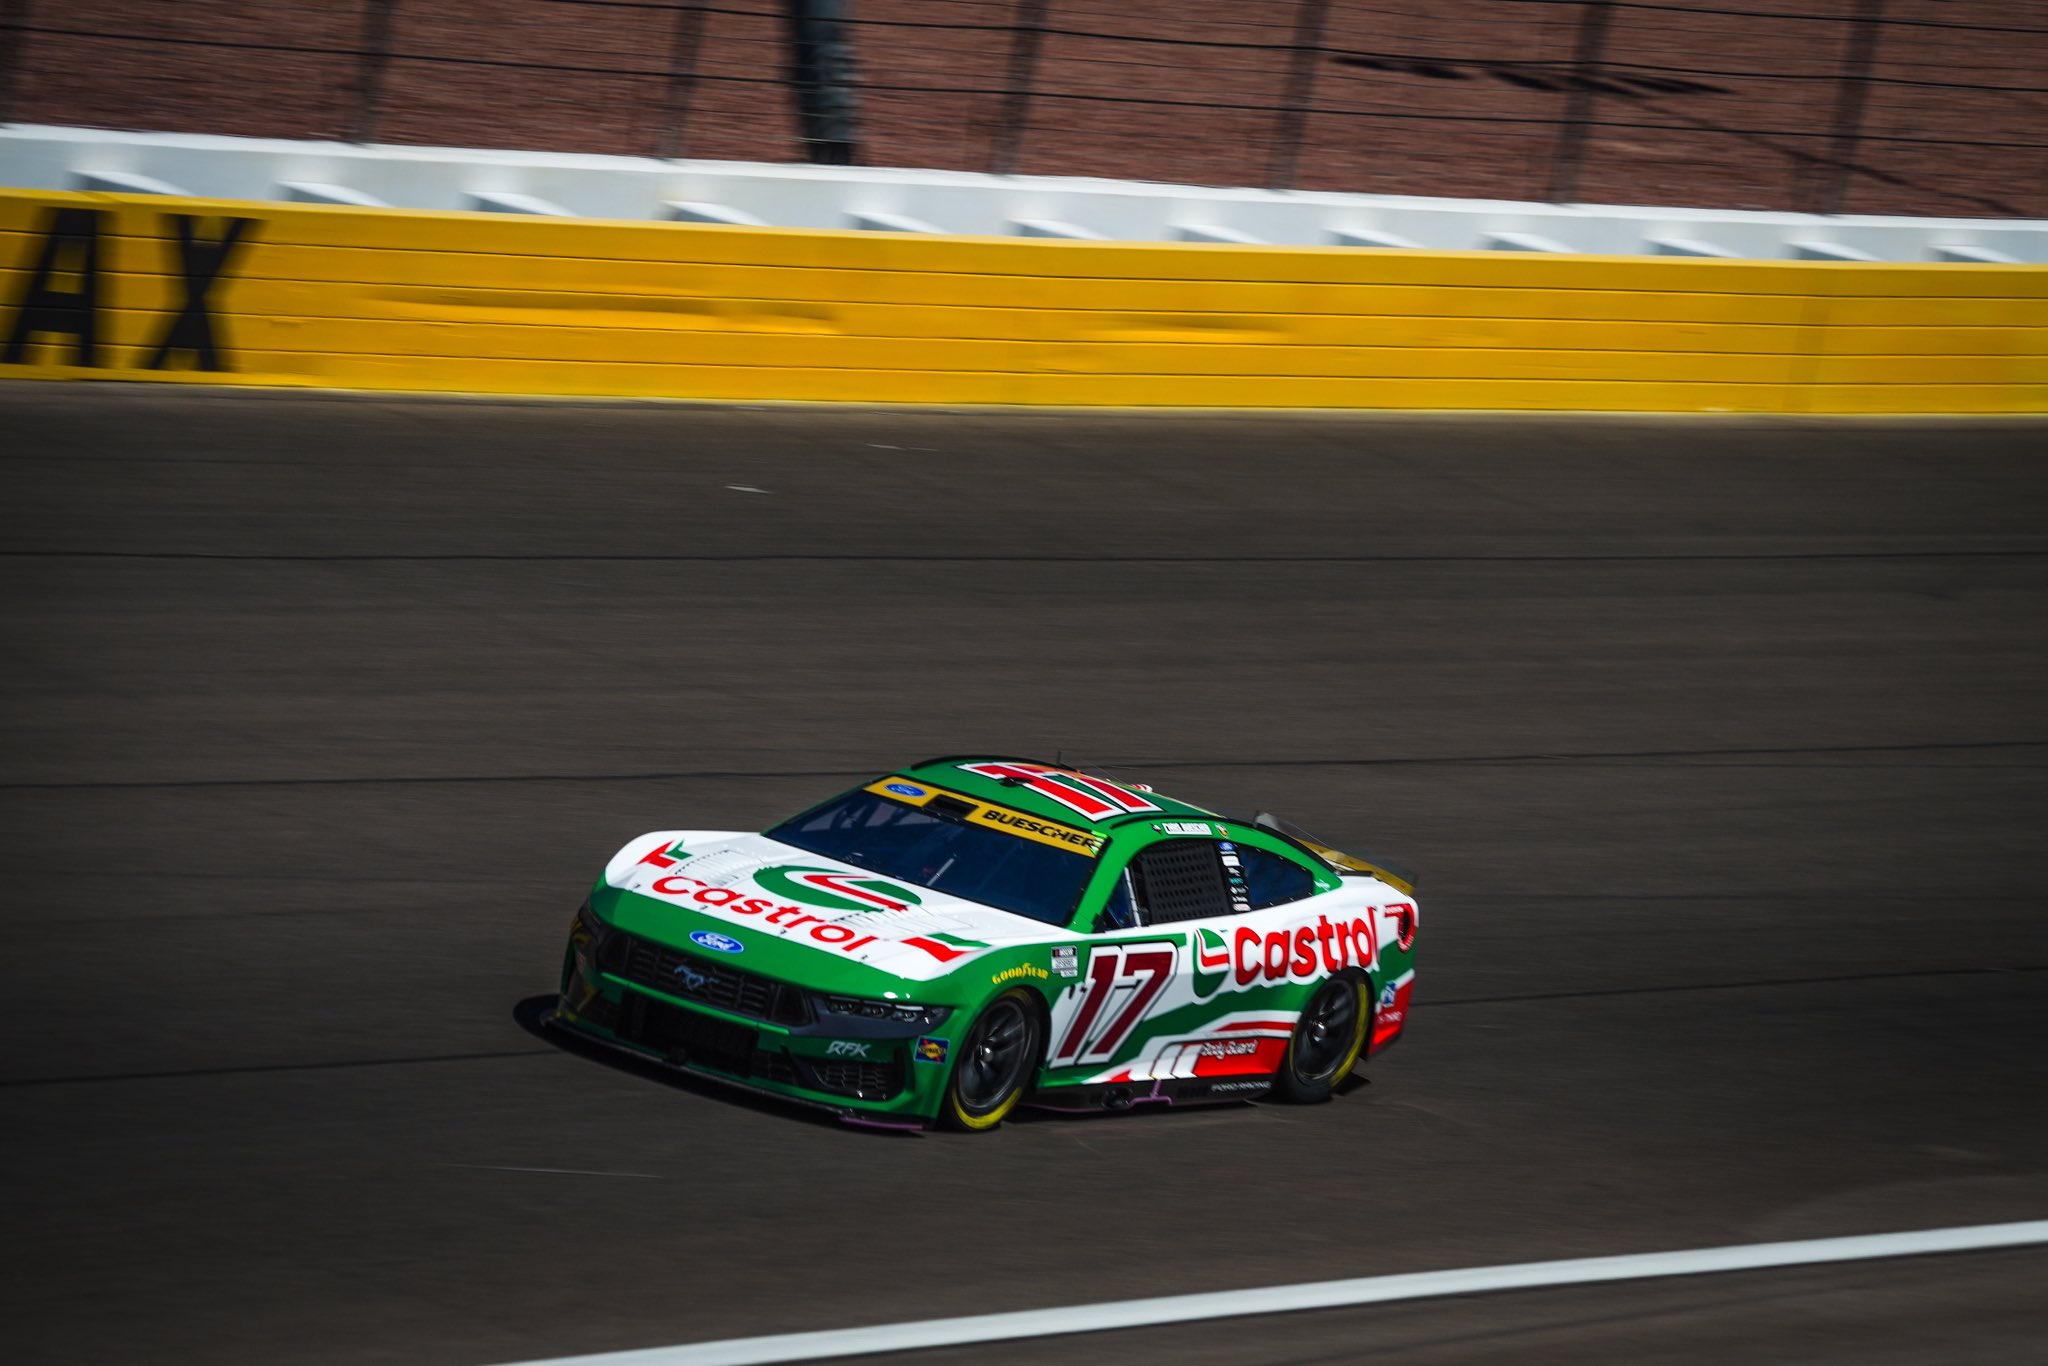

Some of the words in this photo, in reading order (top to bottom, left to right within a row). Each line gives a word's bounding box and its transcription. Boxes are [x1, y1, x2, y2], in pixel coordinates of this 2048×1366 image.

[982, 810, 1097, 849] BUESCHER
[652, 876, 878, 952] Castrol
[697, 932, 736, 951] Ford
[1234, 905, 1379, 985] Castrol
[1050, 942, 1178, 1068] 17
